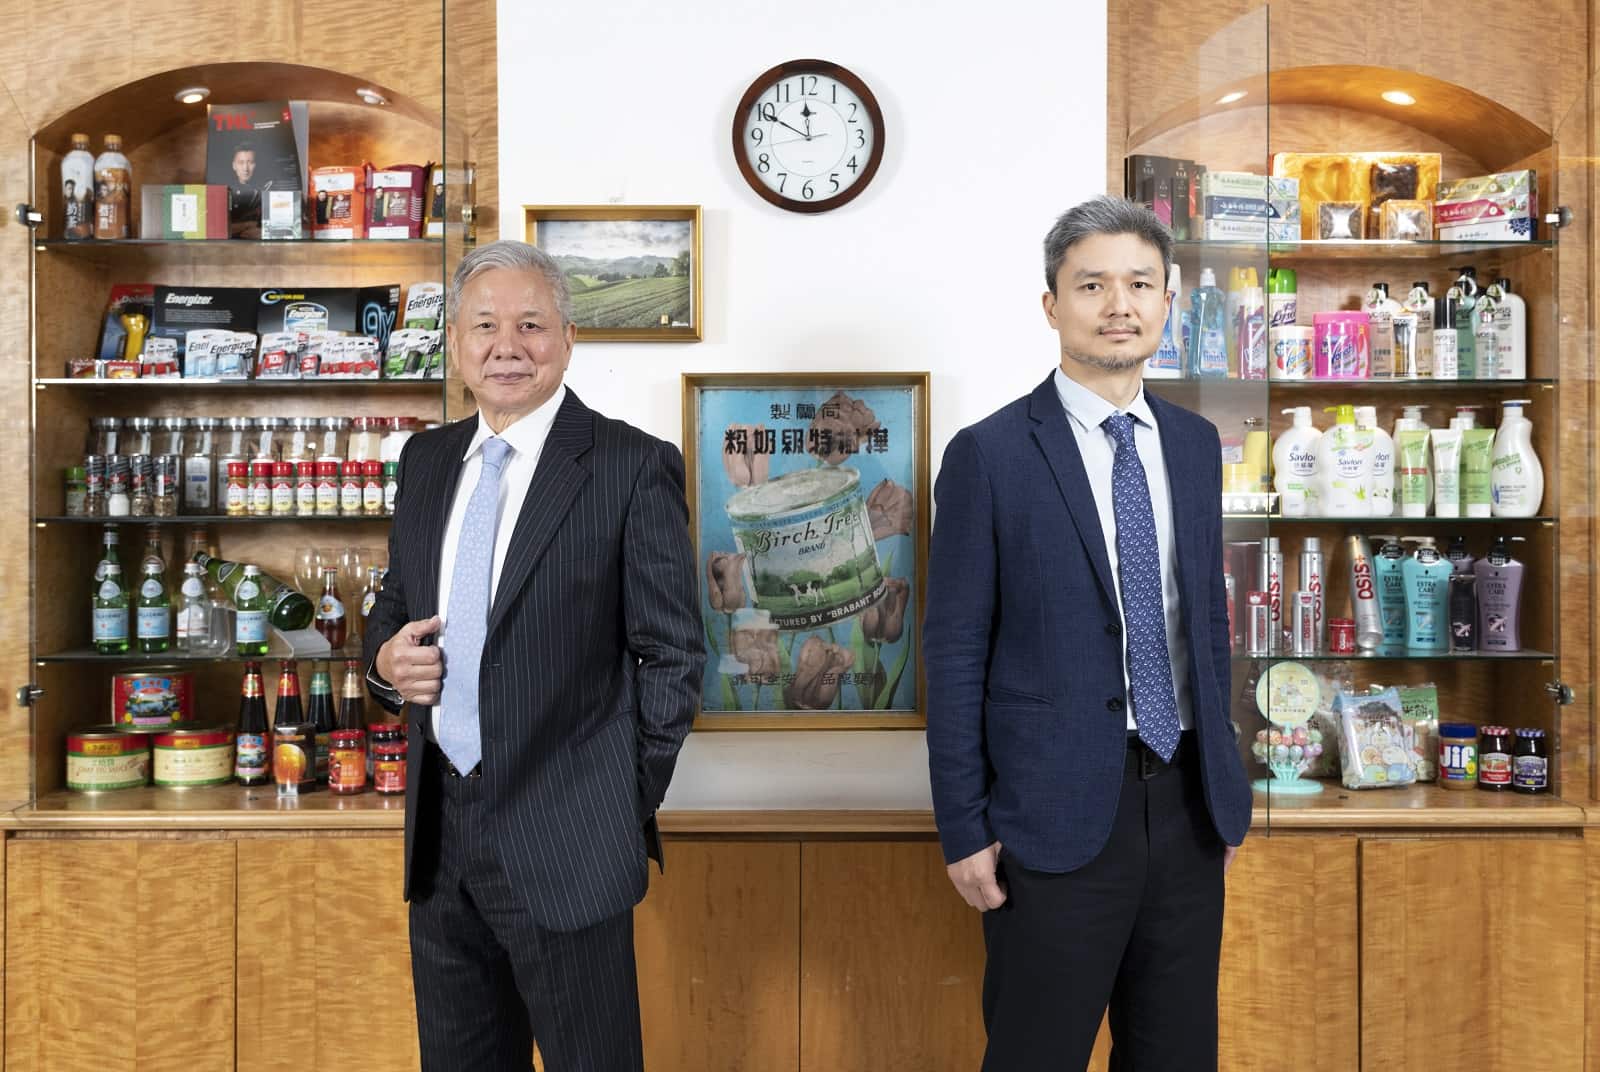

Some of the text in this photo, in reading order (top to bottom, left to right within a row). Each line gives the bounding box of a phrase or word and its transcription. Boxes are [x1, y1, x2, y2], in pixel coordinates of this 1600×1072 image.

[776, 83, 790, 103] 11
[800, 76, 819, 97] 12
[831, 84, 837, 105] 1
[758, 102, 776, 122] 10
[847, 103, 857, 123] 2
[751, 127, 764, 149] 9
[855, 129, 865, 149] 3
[757, 153, 770, 174] 8
[846, 155, 858, 175] 4
[777, 173, 787, 193] 7
[802, 179, 814, 200] 6
[829, 173, 839, 193] 5
[165, 293, 213, 307] Energizer
[209, 338, 254, 356] Energizer
[756, 520, 820, 555] Birch
[823, 508, 861, 535] Tree
[798, 541, 827, 556] BRAND
[810, 613, 823, 624] BY
